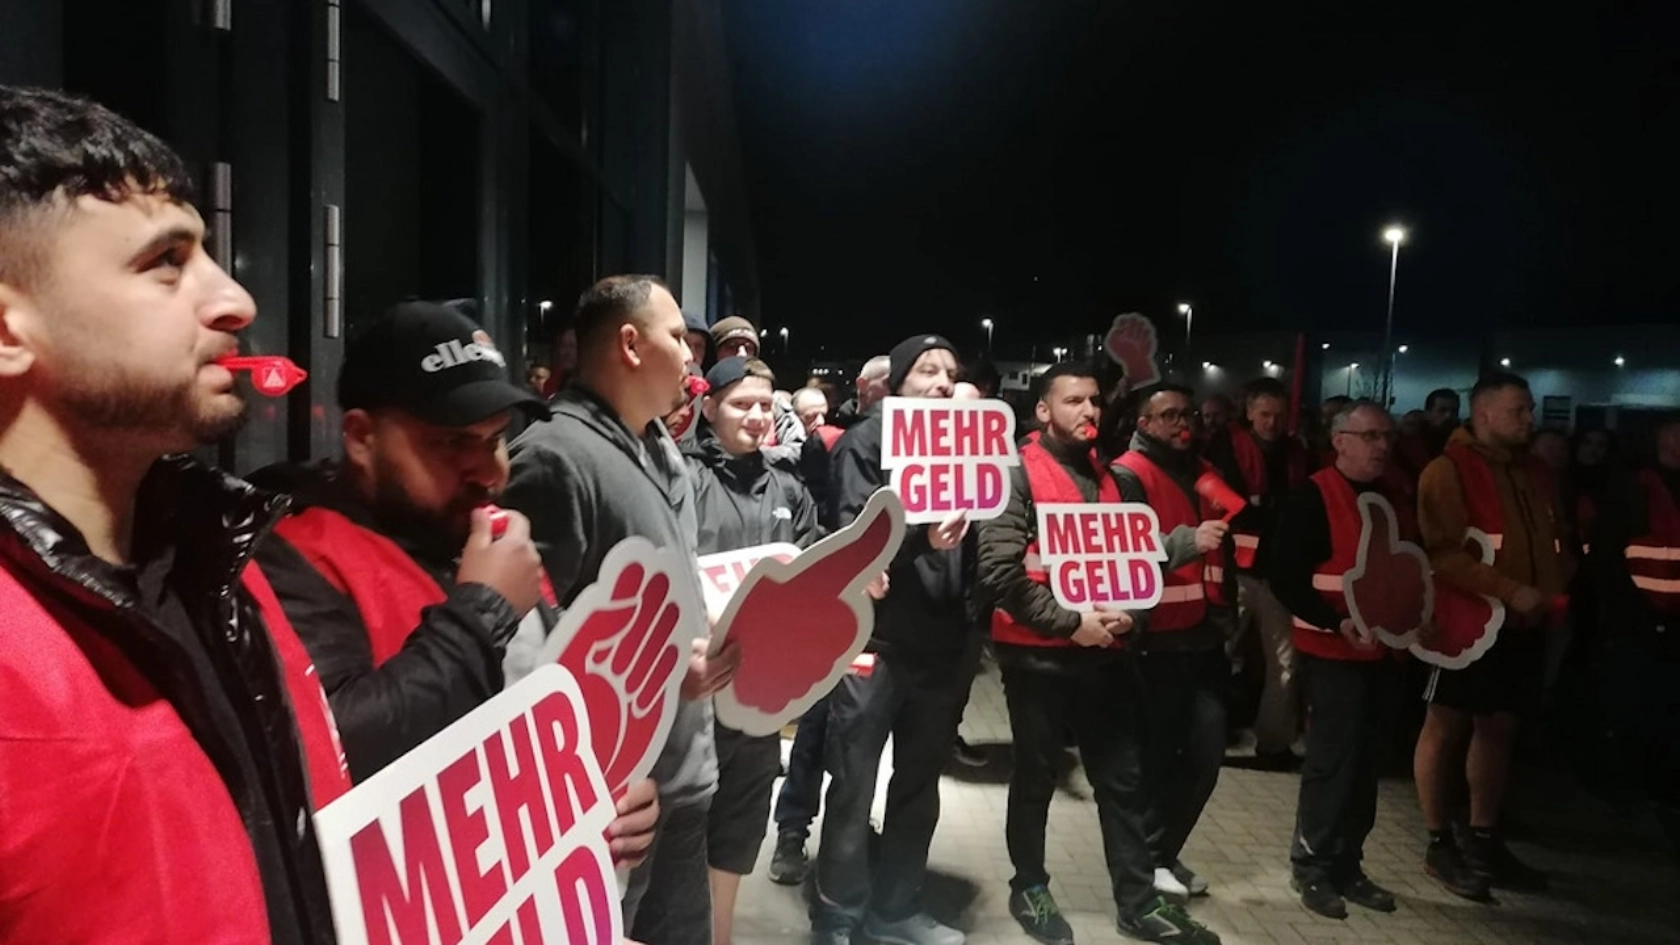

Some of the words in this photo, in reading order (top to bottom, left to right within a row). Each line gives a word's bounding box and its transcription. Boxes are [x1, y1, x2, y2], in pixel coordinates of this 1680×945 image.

[892, 409, 1007, 456] MEHR
[901, 463, 1003, 513] GELD
[1046, 512, 1156, 555] MEHR
[1059, 559, 1155, 603] GELD
[350, 691, 598, 945] MEHR
